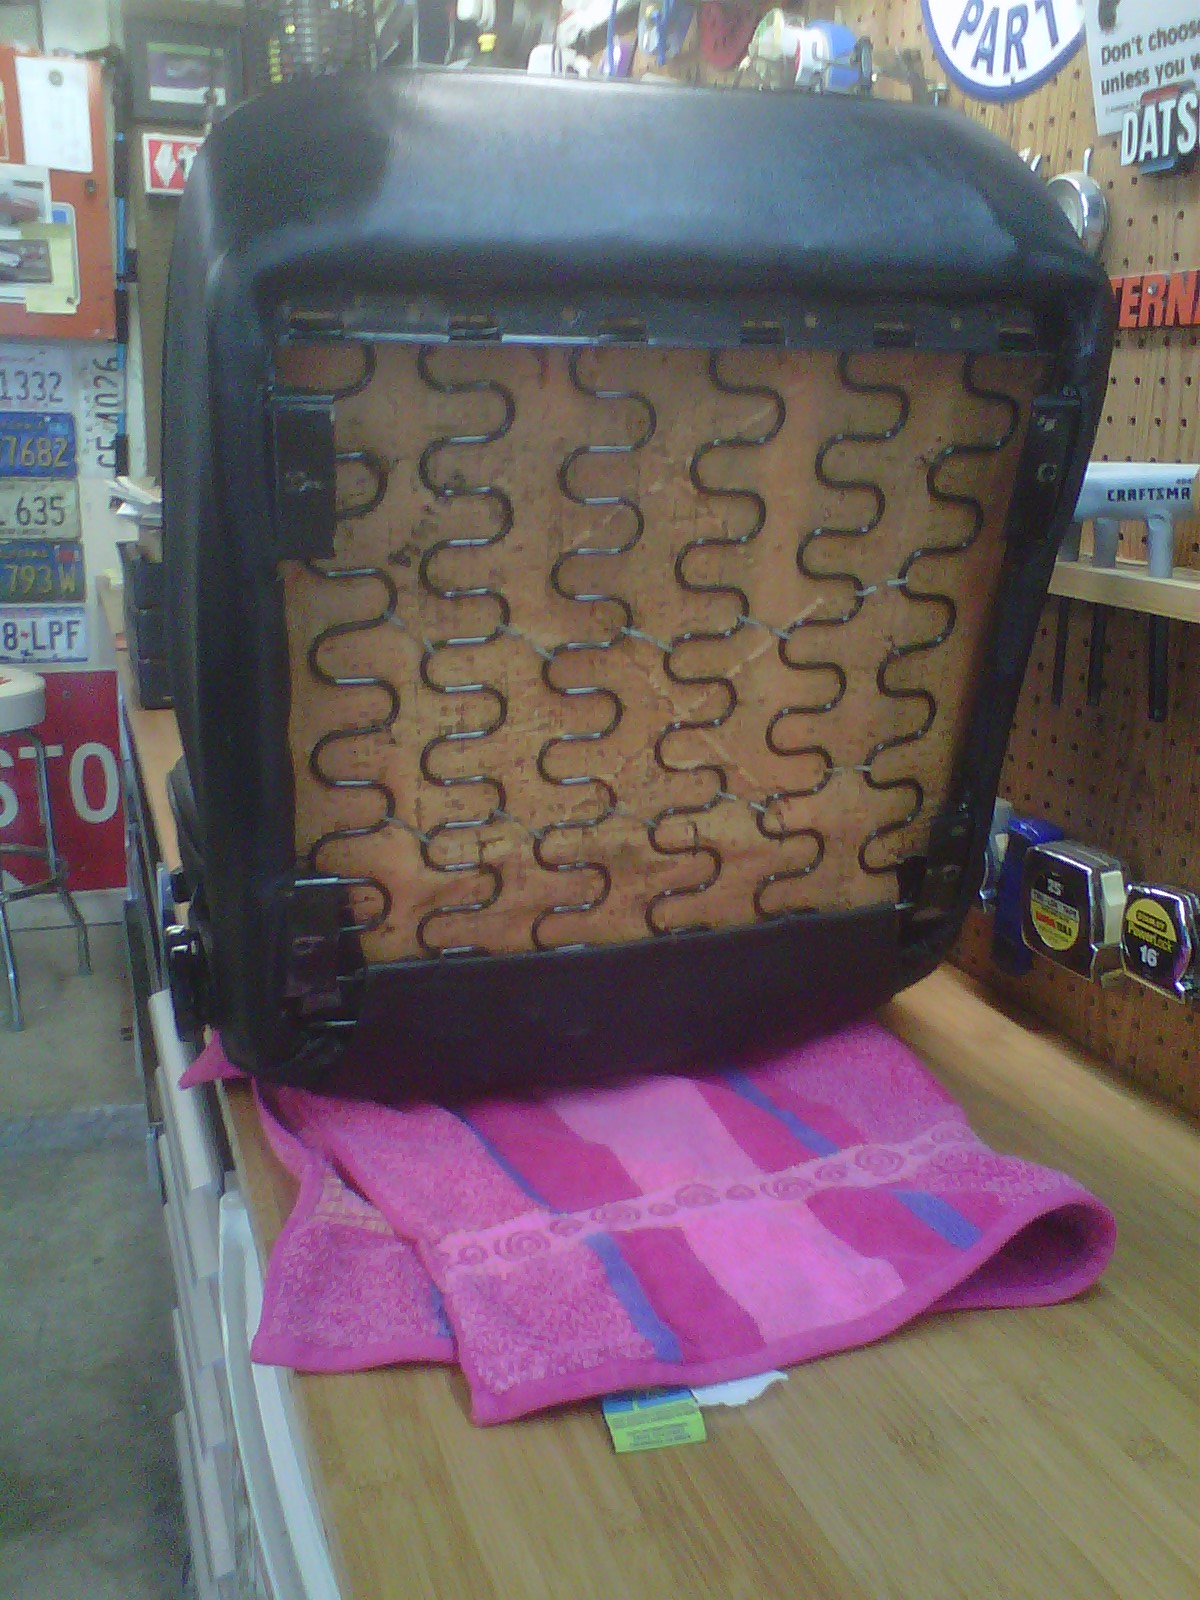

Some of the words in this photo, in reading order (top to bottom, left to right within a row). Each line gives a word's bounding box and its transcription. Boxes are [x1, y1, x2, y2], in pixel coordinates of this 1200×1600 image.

[1101, 34, 1143, 66] Don't
[1148, 18, 1200, 51] choos
[1101, 67, 1150, 96] unless
[1155, 57, 1185, 87] you
[1120, 92, 1200, 166] DATS
[1110, 268, 1200, 328] ERN
[2, 434, 68, 468] 7682
[15, 495, 66, 527] 635
[1139, 945, 1158, 968] 16
